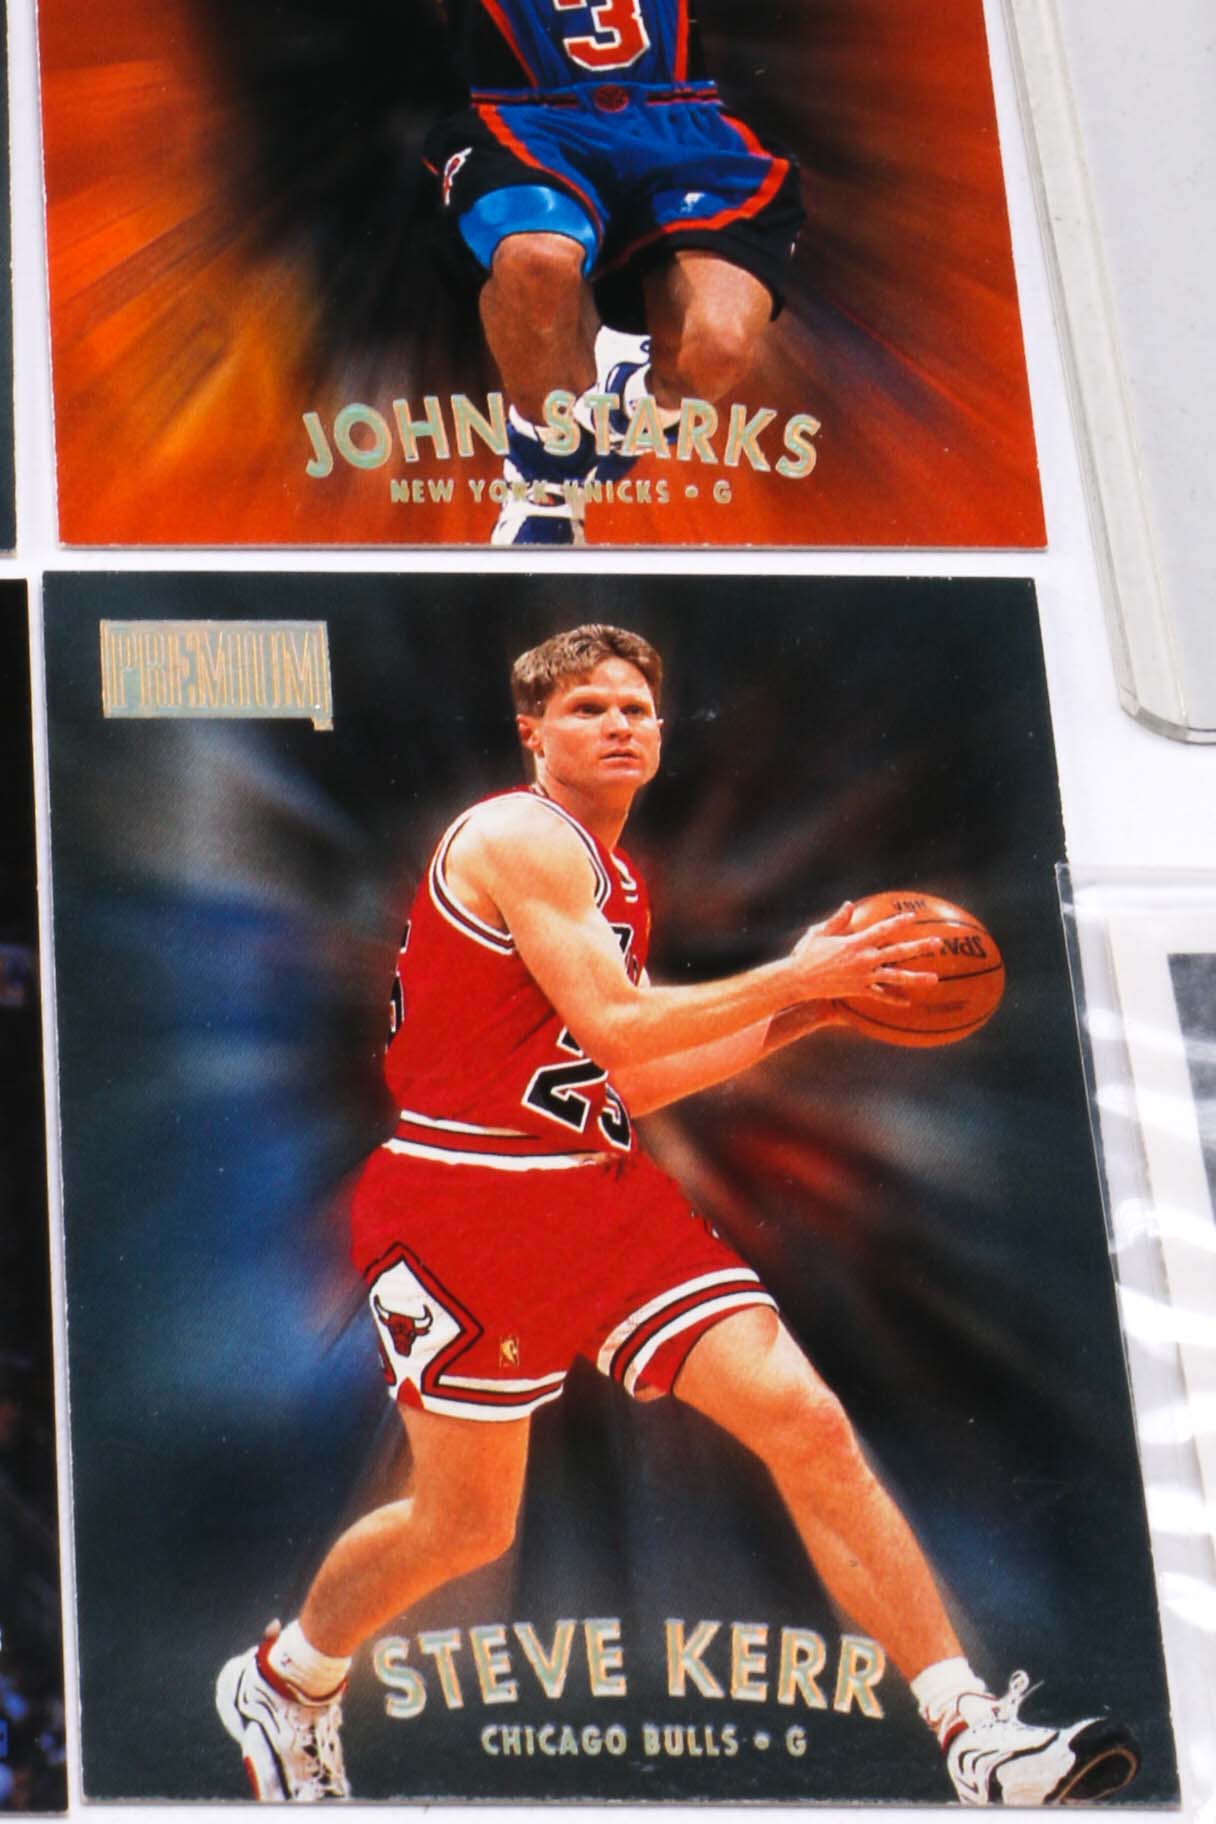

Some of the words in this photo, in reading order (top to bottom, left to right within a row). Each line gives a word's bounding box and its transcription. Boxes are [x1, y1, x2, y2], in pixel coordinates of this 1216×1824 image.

[302, 391, 510, 479] JOHN
[542, 389, 822, 480] STARKS
[390, 479, 453, 503] NEW
[469, 479, 548, 504] YORK
[563, 479, 671, 504] KNICKS
[712, 480, 733, 504] G
[373, 1618, 628, 1719] STEVE
[665, 1617, 886, 1719] KERR
[481, 1725, 627, 1756] CHICAGO
[643, 1724, 739, 1757] BULLS
[786, 1725, 808, 1757] G
